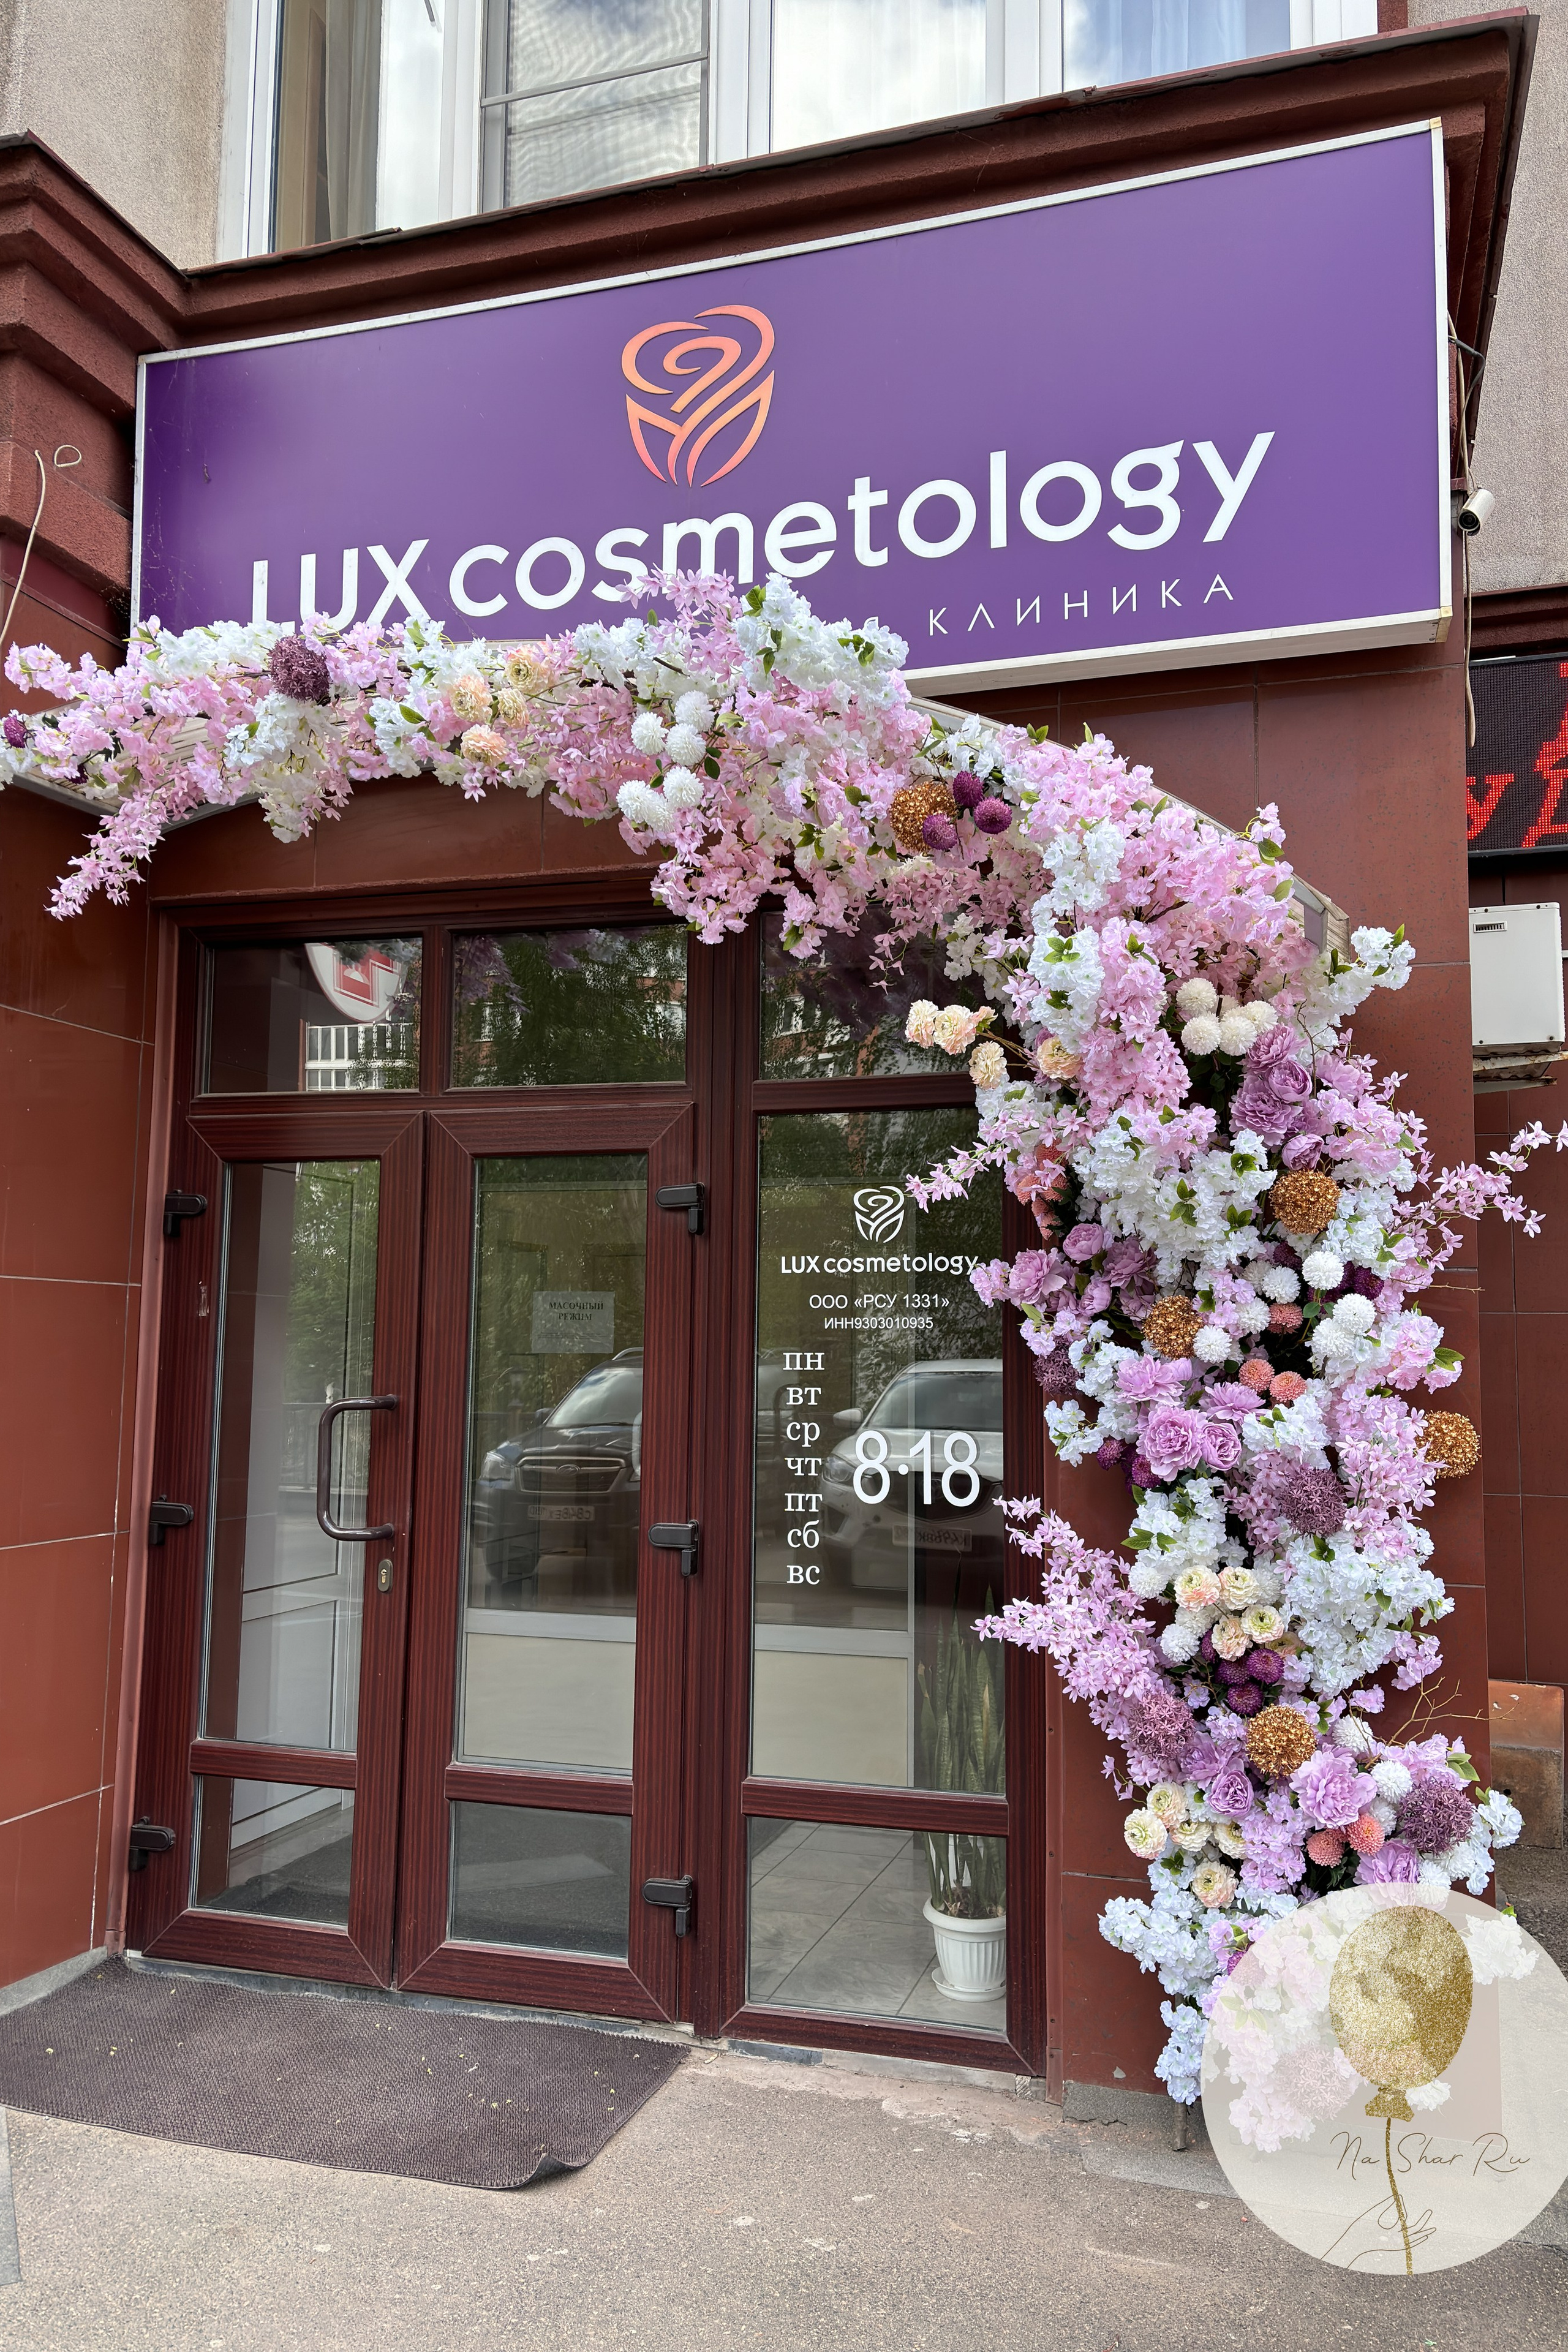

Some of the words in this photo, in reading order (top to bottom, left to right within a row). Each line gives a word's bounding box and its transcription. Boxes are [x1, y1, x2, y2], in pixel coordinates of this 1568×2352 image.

[252, 539, 430, 635] LUX
[449, 432, 1275, 617] cosmetology
[929, 574, 1234, 636] КЛИНИКА
[781, 1255, 820, 1274] LUX
[823, 1253, 979, 1275] cosmetology
[549, 1301, 603, 1310] МАСОЧНЫЙ
[809, 1294, 848, 1310] ООО
[854, 1294, 896, 1310] «РСУ
[903, 1294, 950, 1309] 1331»
[559, 1313, 592, 1321] РЕЖИМ
[824, 1317, 933, 1330] ИНН9303010935
[783, 1352, 825, 1371] пн
[786, 1387, 821, 1406] вт
[786, 1422, 821, 1447] ср
[785, 1457, 822, 1476] чт
[785, 1493, 823, 1512] пт
[787, 1520, 820, 1548] сб
[786, 1565, 820, 1585] вс
